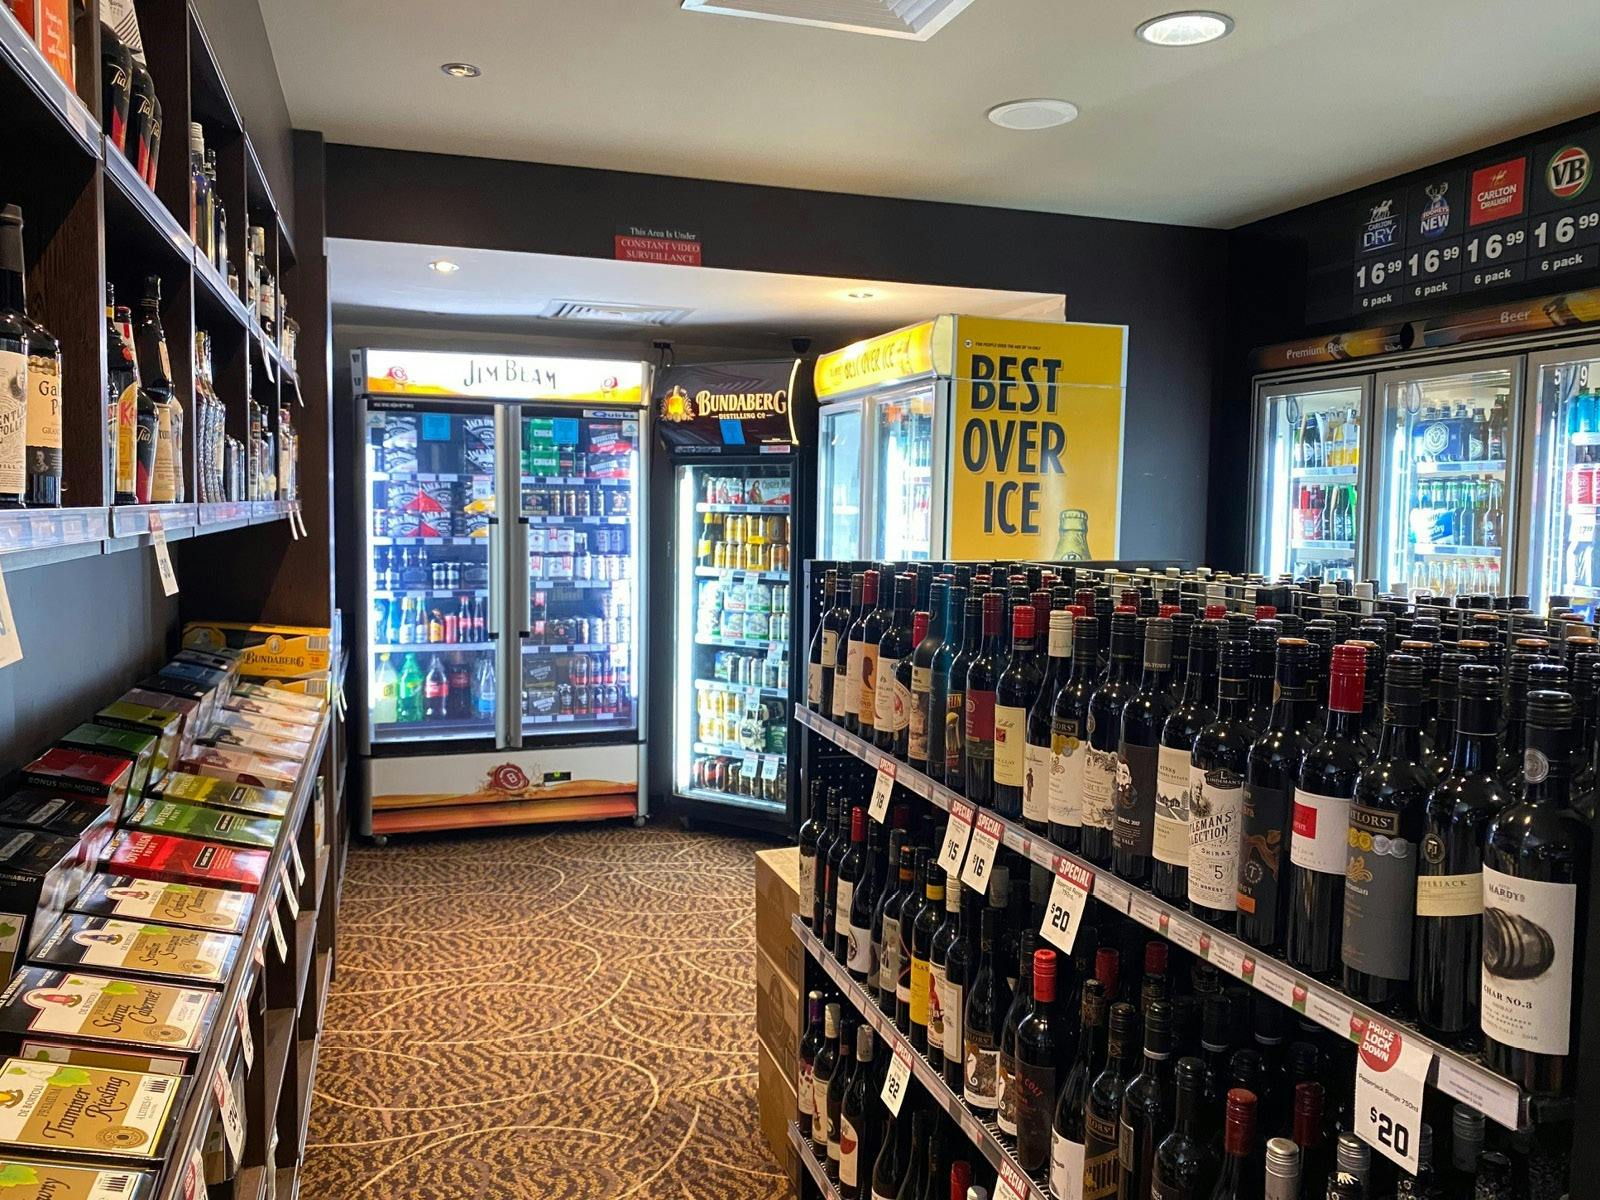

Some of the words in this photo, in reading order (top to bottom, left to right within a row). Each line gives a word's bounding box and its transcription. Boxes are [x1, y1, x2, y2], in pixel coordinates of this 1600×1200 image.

[1552, 158, 1585, 186] VB
[1477, 184, 1517, 202] CARLTON
[1480, 195, 1512, 210] DRAUGHT
[631, 227, 646, 236] This
[666, 230, 672, 238] Is
[674, 231, 696, 240] Under
[1368, 220, 1392, 230] CARLTON
[1420, 215, 1449, 233] NEW
[621, 238, 670, 250] CONSTANT
[672, 243, 700, 252] VIDEO
[1363, 225, 1396, 248] DRY
[626, 250, 694, 262] SURVEILLANCE
[1542, 261, 1549, 270] 6
[1553, 254, 1583, 270] pack
[1474, 275, 1481, 284] 6
[1485, 269, 1511, 284] pack
[1415, 288, 1421, 296] 6
[1424, 282, 1448, 296] pack
[1362, 298, 1368, 307] 6
[1371, 294, 1392, 306] pack
[1500, 310, 1531, 324] Beer
[1286, 346, 1326, 360] Premium
[1328, 342, 1348, 354] Beer
[464, 360, 498, 387] JIM
[505, 359, 556, 389] BEAM
[972, 354, 1062, 413] BEST
[696, 390, 787, 416] BUNDABERG
[963, 418, 1066, 474] OVER
[984, 481, 1040, 533] ICE
[244, 651, 304, 668] BUNDABERG
[952, 801, 974, 822] SPECIAL
[978, 814, 1002, 837] SPECIAL
[948, 839, 960, 861] $15
[1201, 848, 1231, 857] SHIRAZ
[973, 854, 984, 877] $16
[1058, 858, 1090, 887] SPECIAL
[1214, 865, 1223, 880] 5
[1488, 884, 1525, 902] HARDYS
[1051, 902, 1070, 932] $20
[128, 989, 162, 1024] Cabernet
[1484, 984, 1502, 1000] CHAR
[1506, 996, 1532, 1009] NO.3
[93, 1004, 132, 1033] Shiraz
[1366, 1030, 1392, 1052] LOCK
[1368, 1020, 1394, 1040] PRICE
[1362, 1041, 1390, 1062] DOWN
[22, 1085, 44, 1110] BORTOLI
[888, 1074, 900, 1100] $22
[37, 1088, 62, 1118] PREMIUM
[85, 1076, 130, 1122] Riesling
[1402, 1098, 1419, 1113] 750ml
[18, 1109, 27, 1118] DE
[42, 1087, 91, 1139] Traminer
[1370, 1106, 1409, 1158] $20
[1000, 1160, 1028, 1198] SPECIAL
